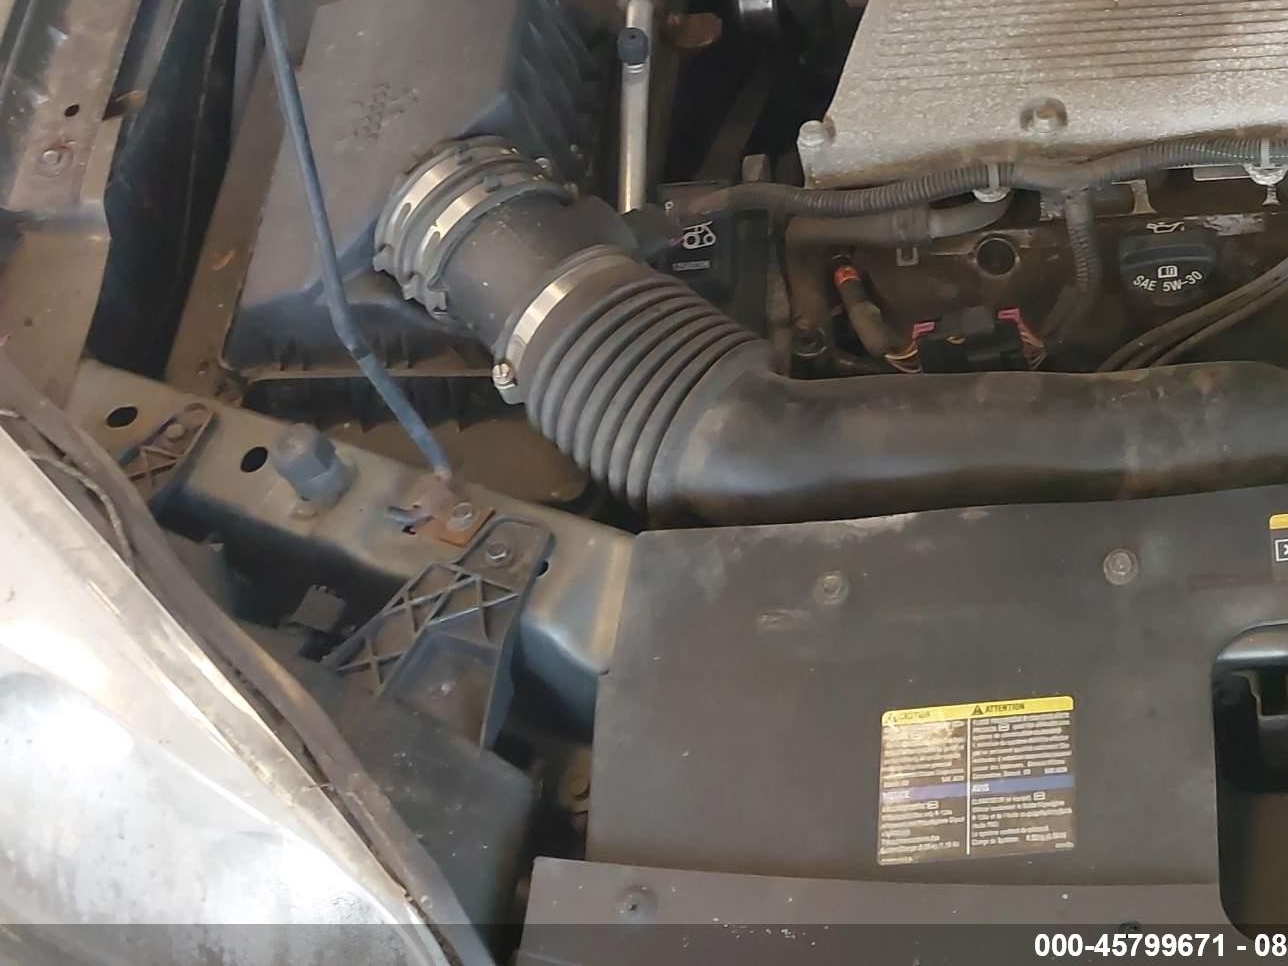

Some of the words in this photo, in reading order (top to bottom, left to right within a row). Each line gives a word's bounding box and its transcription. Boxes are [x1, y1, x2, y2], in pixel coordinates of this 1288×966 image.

[1133, 275, 1157, 291] SAE
[1162, 270, 1203, 292] 5W-30
[985, 703, 1025, 713] ATTENTION
